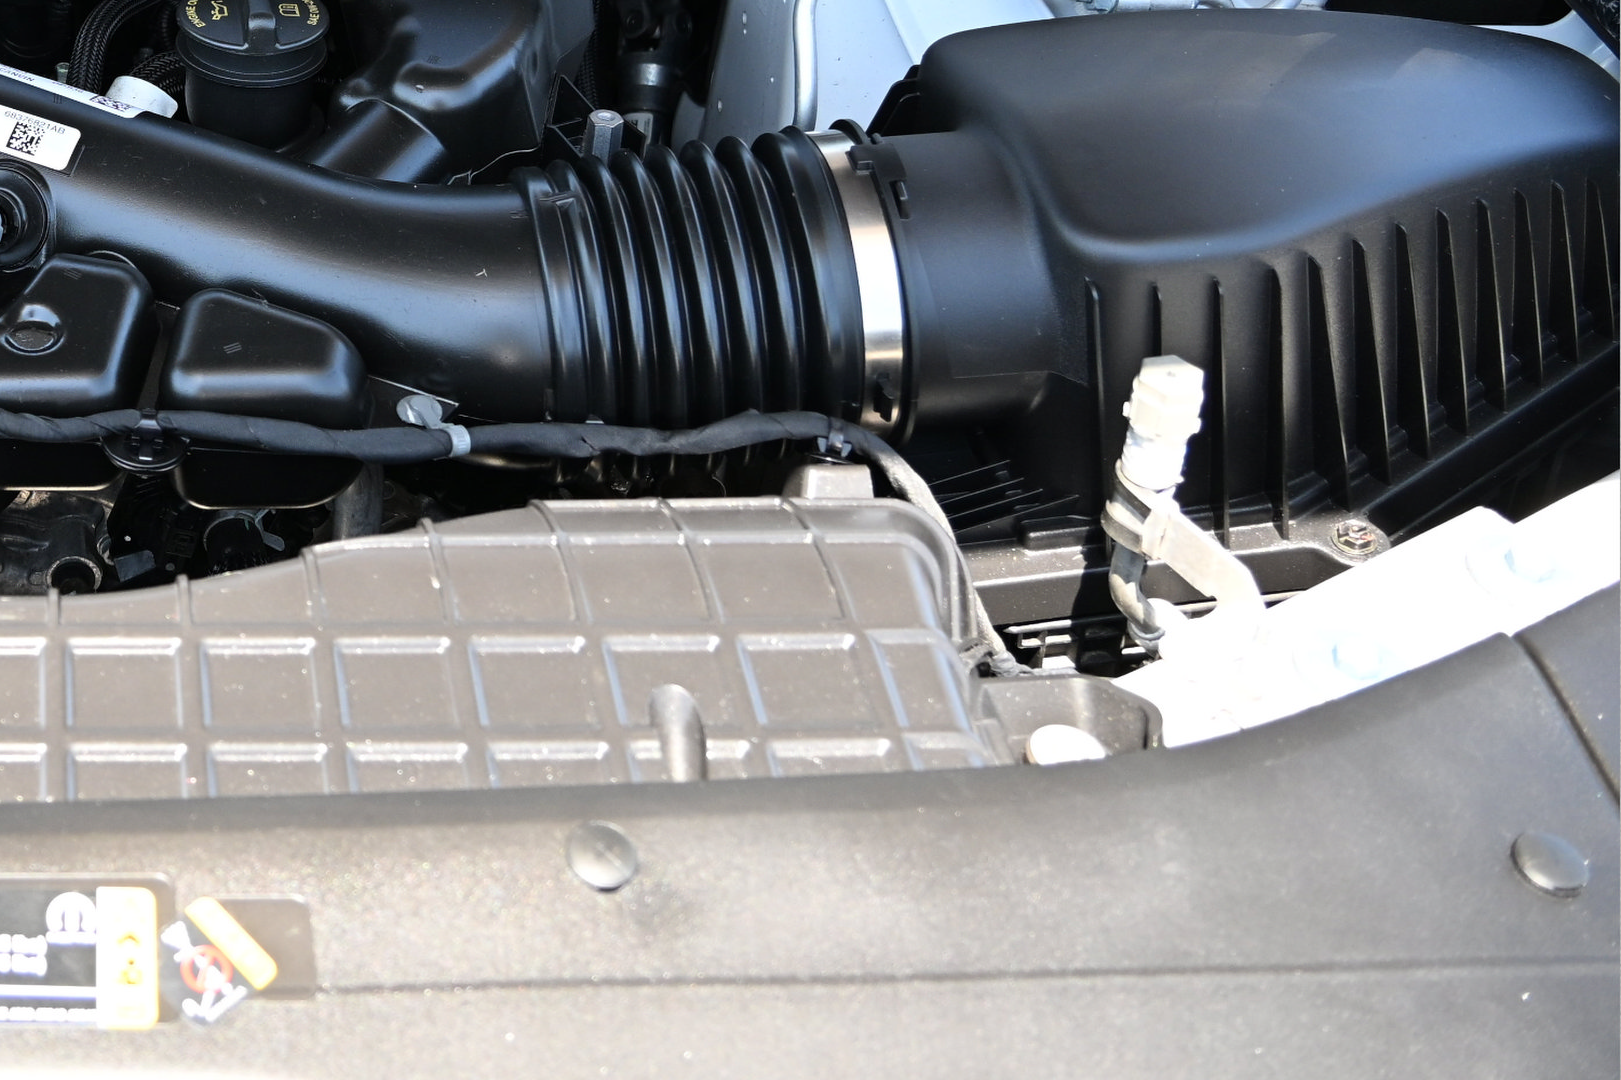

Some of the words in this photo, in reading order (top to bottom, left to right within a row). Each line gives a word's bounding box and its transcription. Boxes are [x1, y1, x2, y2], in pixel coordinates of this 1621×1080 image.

[185, 6, 206, 28] ENGINE
[307, 13, 320, 26] SAE
[4, 110, 66, 135] 68376821AB
